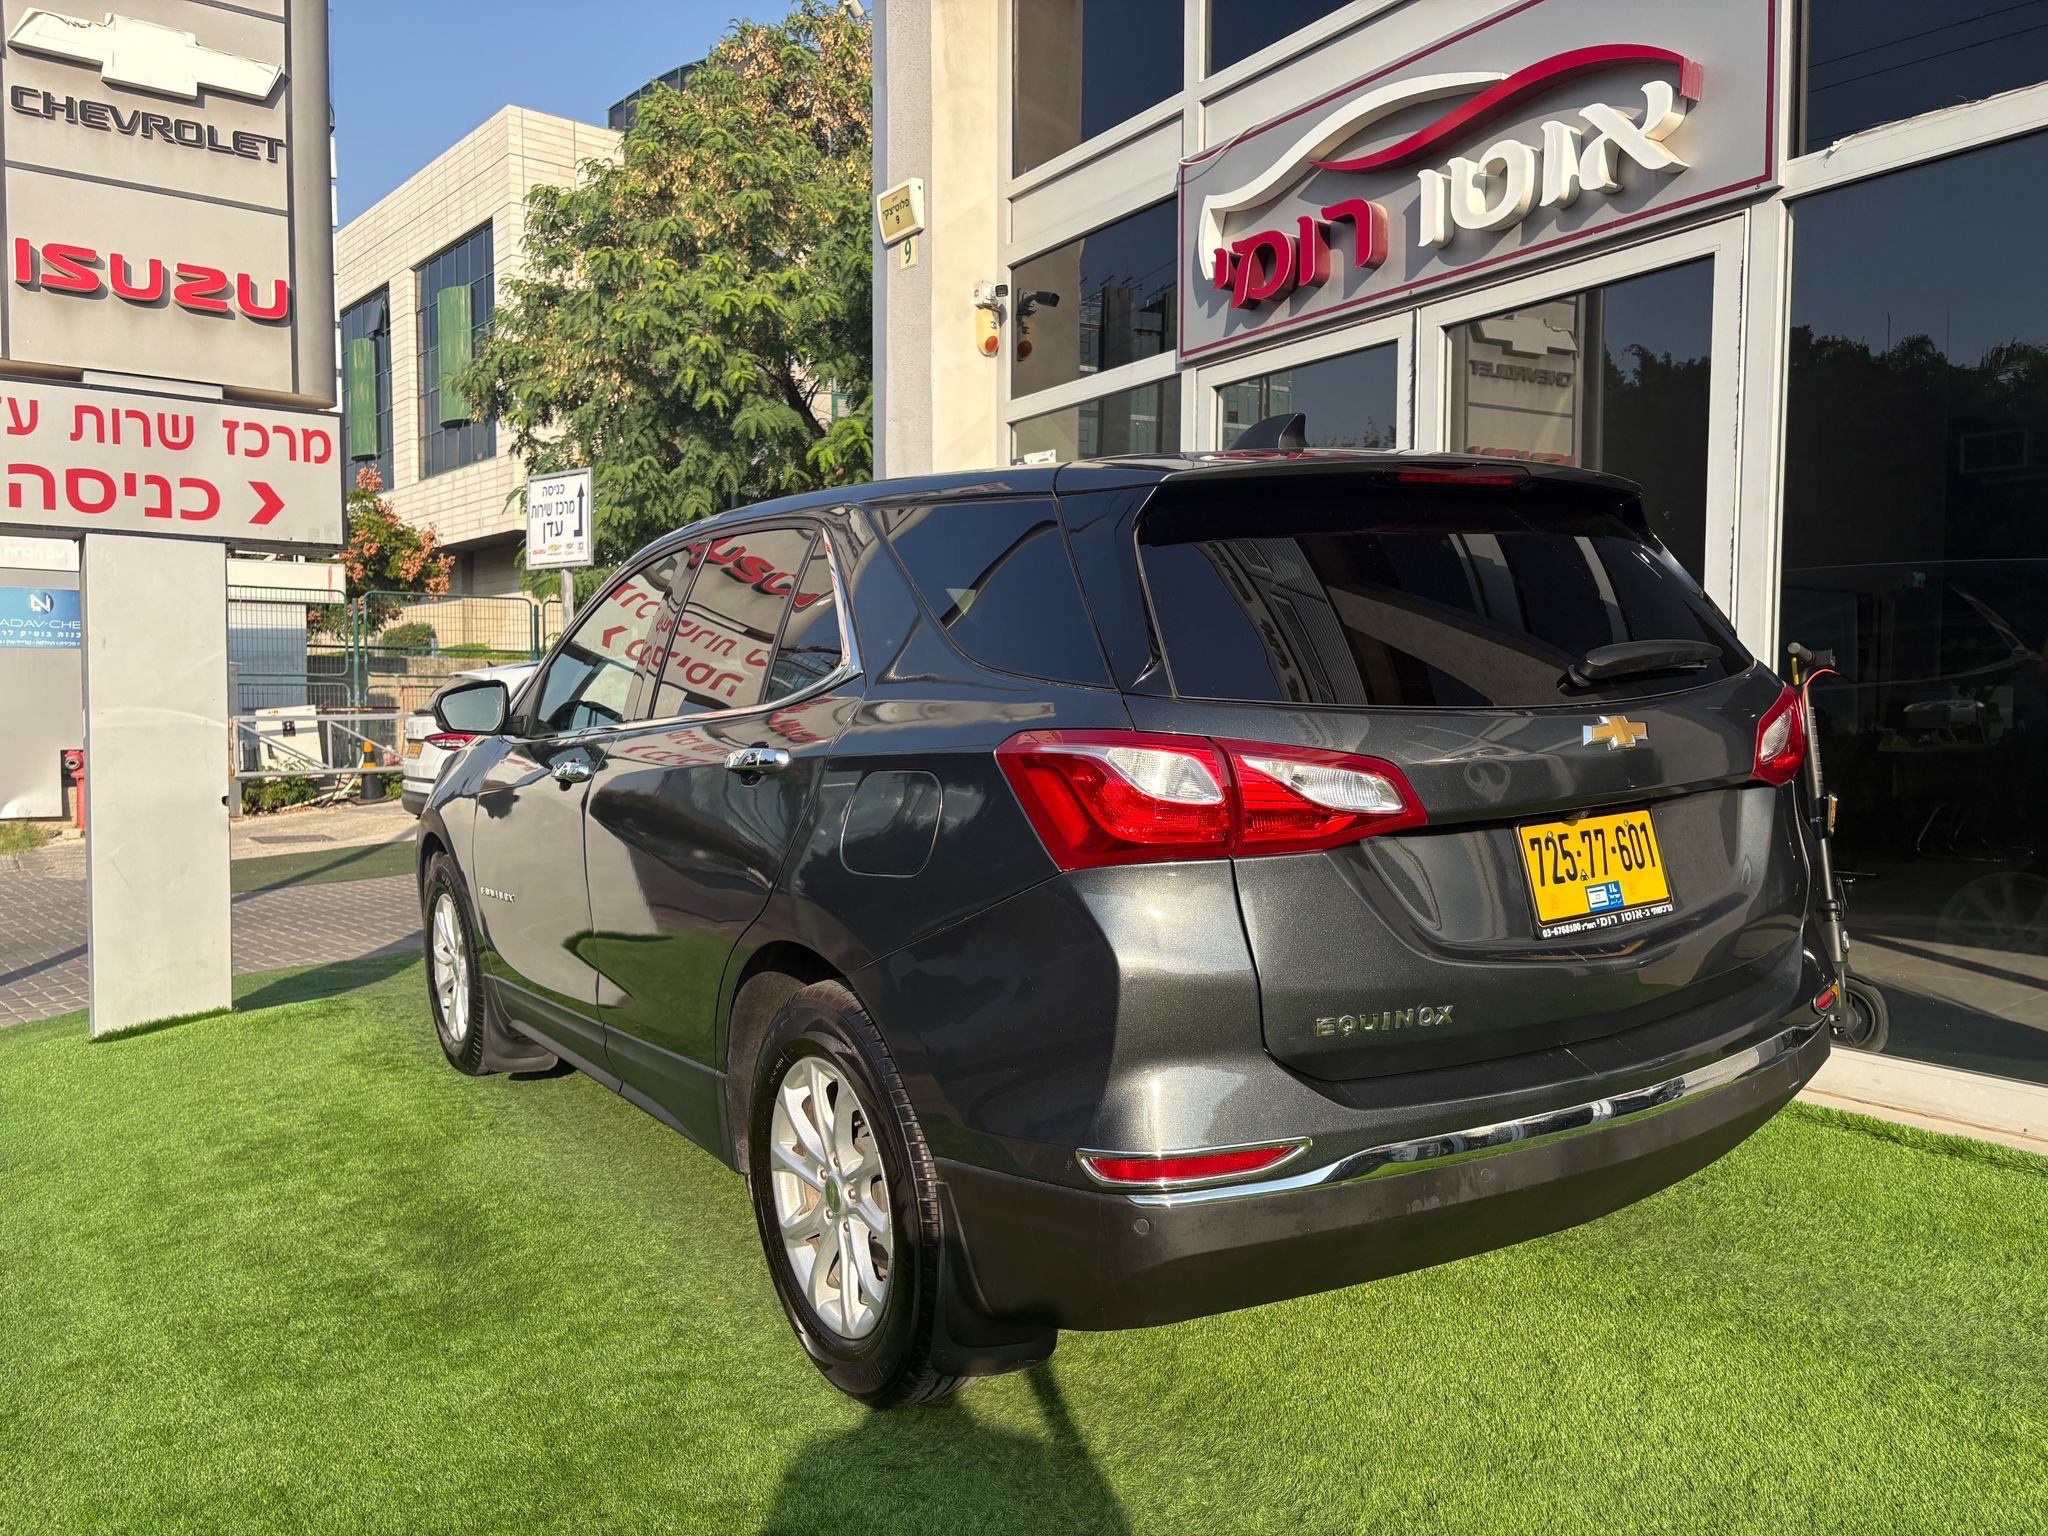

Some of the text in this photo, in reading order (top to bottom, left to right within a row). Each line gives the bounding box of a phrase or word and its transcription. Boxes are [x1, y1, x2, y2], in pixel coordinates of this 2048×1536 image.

[9, 84, 286, 162] CHEVROLET
[1213, 80, 1690, 309] אוטו רומי
[904, 238, 912, 265] 9
[14, 237, 290, 320] ISUZU
[0, 396, 332, 465] מרכז שרות ע
[8, 463, 221, 522] כניסה
[542, 483, 565, 497] כניסה
[555, 500, 575, 516] מרכז
[543, 520, 564, 544] עדן
[1315, 1005, 1454, 1038] EQUINOX
